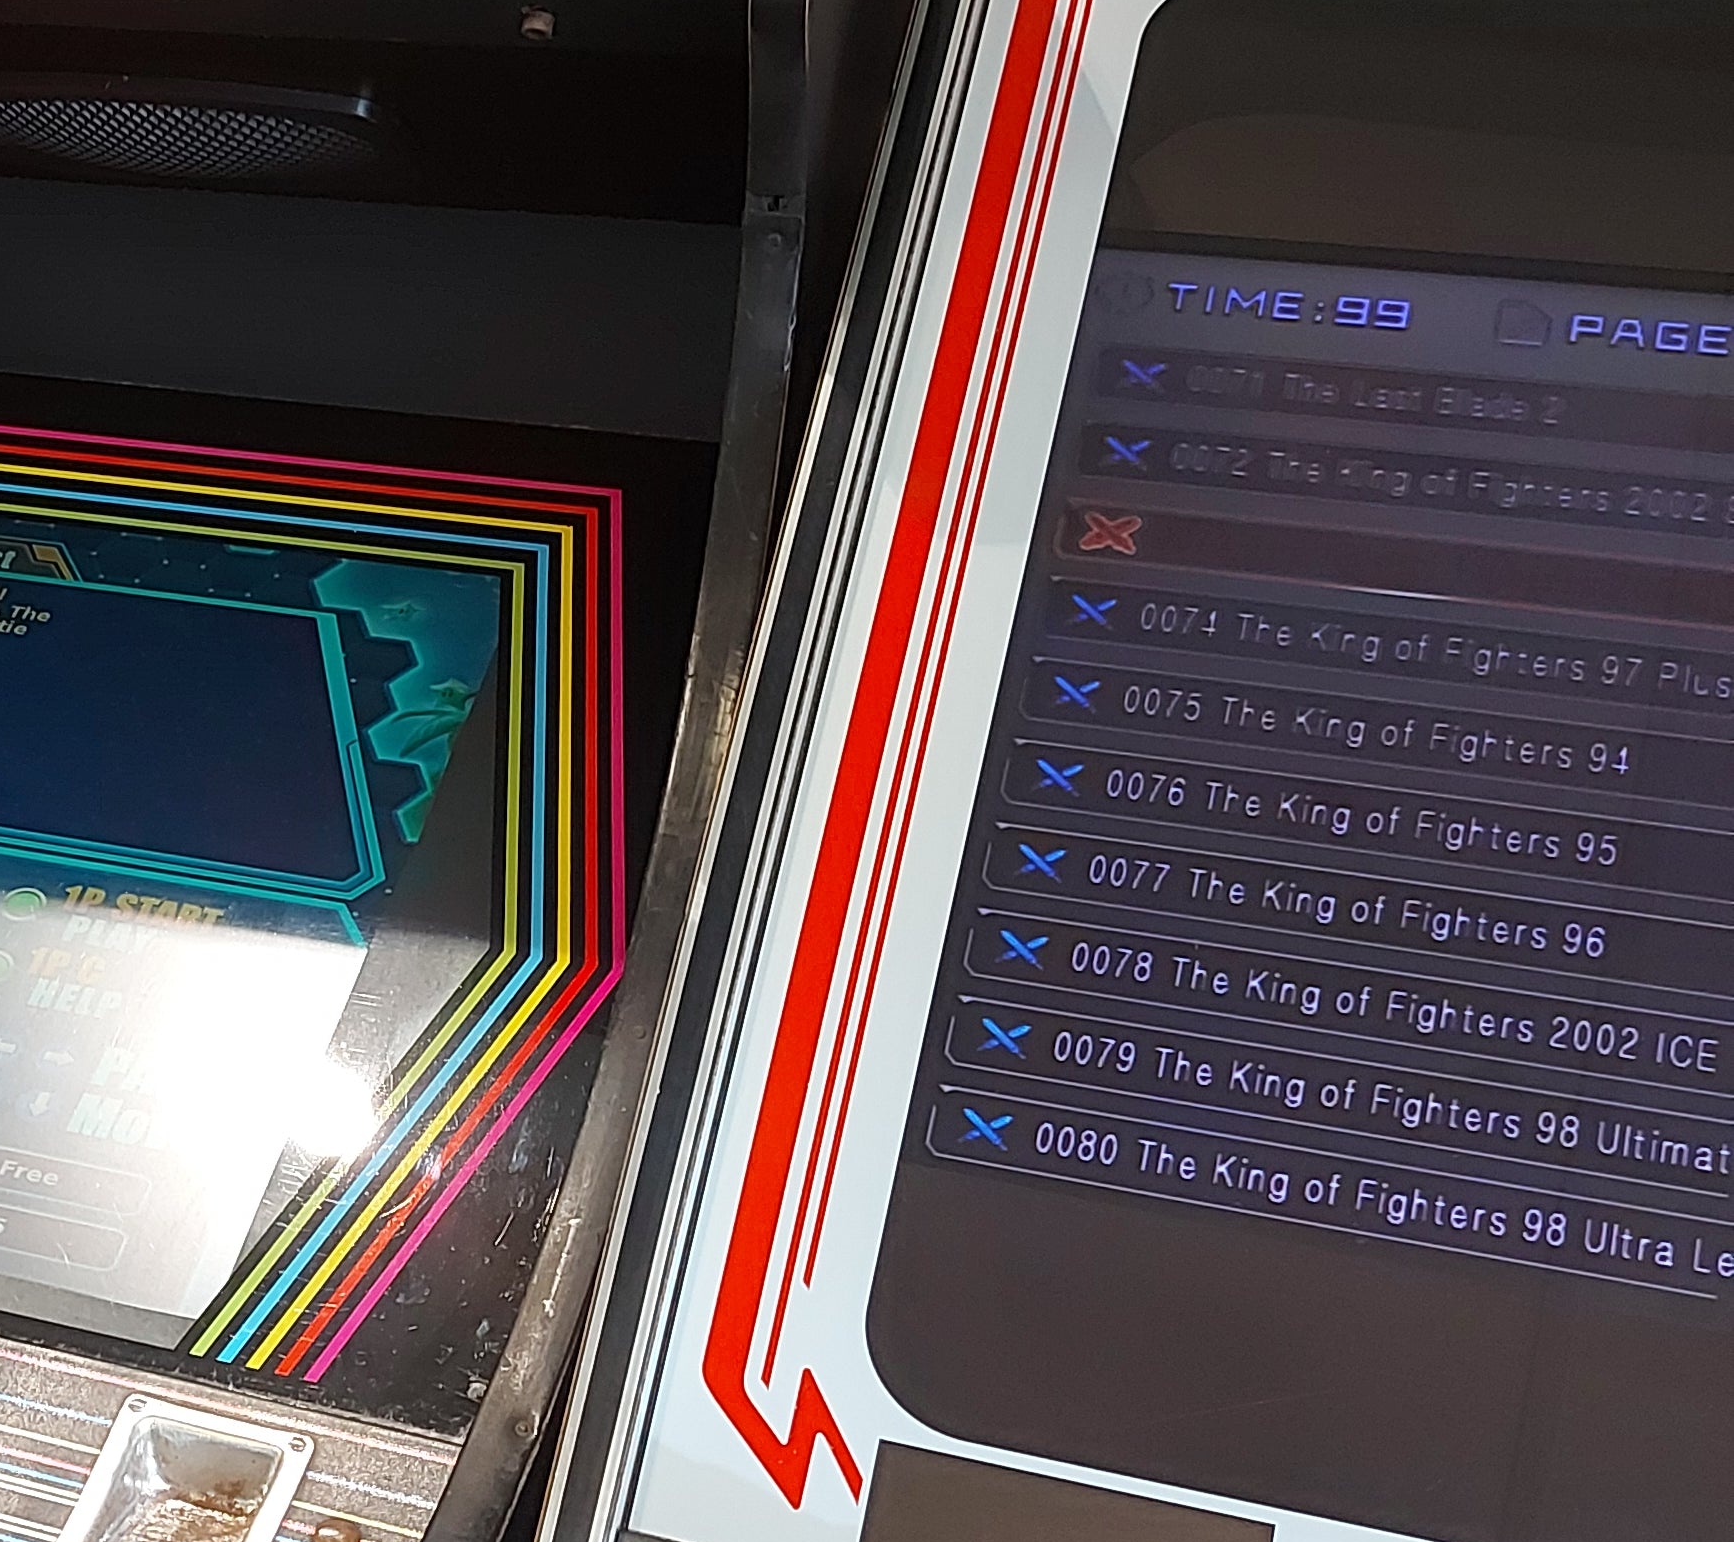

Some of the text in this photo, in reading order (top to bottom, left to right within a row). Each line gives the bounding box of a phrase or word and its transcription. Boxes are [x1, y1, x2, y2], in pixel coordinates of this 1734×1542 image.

[1169, 282, 1733, 355] TIME:99 PAGE
[11, 605, 51, 622] The
[1140, 603, 1218, 637] 0074
[1237, 613, 1293, 647] The
[1310, 622, 1381, 662] King
[1394, 634, 1429, 662] of
[1445, 637, 1586, 682] Fighters
[1601, 656, 1642, 686] 97
[1123, 685, 1629, 775] 0075 The King of Fighters 94
[1106, 770, 1619, 866] 0076 The King of Fighters 95
[64, 886, 225, 924] 1P START
[1089, 854, 1606, 958] 0077 The King of Fighters 96
[27, 978, 123, 1017] HELP
[1072, 942, 1720, 1072] 0078 The King of Fighters 2002 ICE
[1054, 1032, 1136, 1072] 0079
[1155, 1047, 1213, 1086] The
[1229, 1061, 1305, 1107] King
[1320, 1078, 1357, 1110] of
[1370, 1083, 1521, 1139] Fighters
[1536, 1111, 1580, 1148] 98
[1036, 1122, 1118, 1165] 0080
[1138, 1138, 1197, 1180] The
[1213, 1154, 1289, 1203] King
[1305, 1173, 1341, 1205] of
[1355, 1178, 1508, 1237] Fighters
[1522, 1208, 1566, 1247] 98
[1584, 1218, 1674, 1267] Ultra
